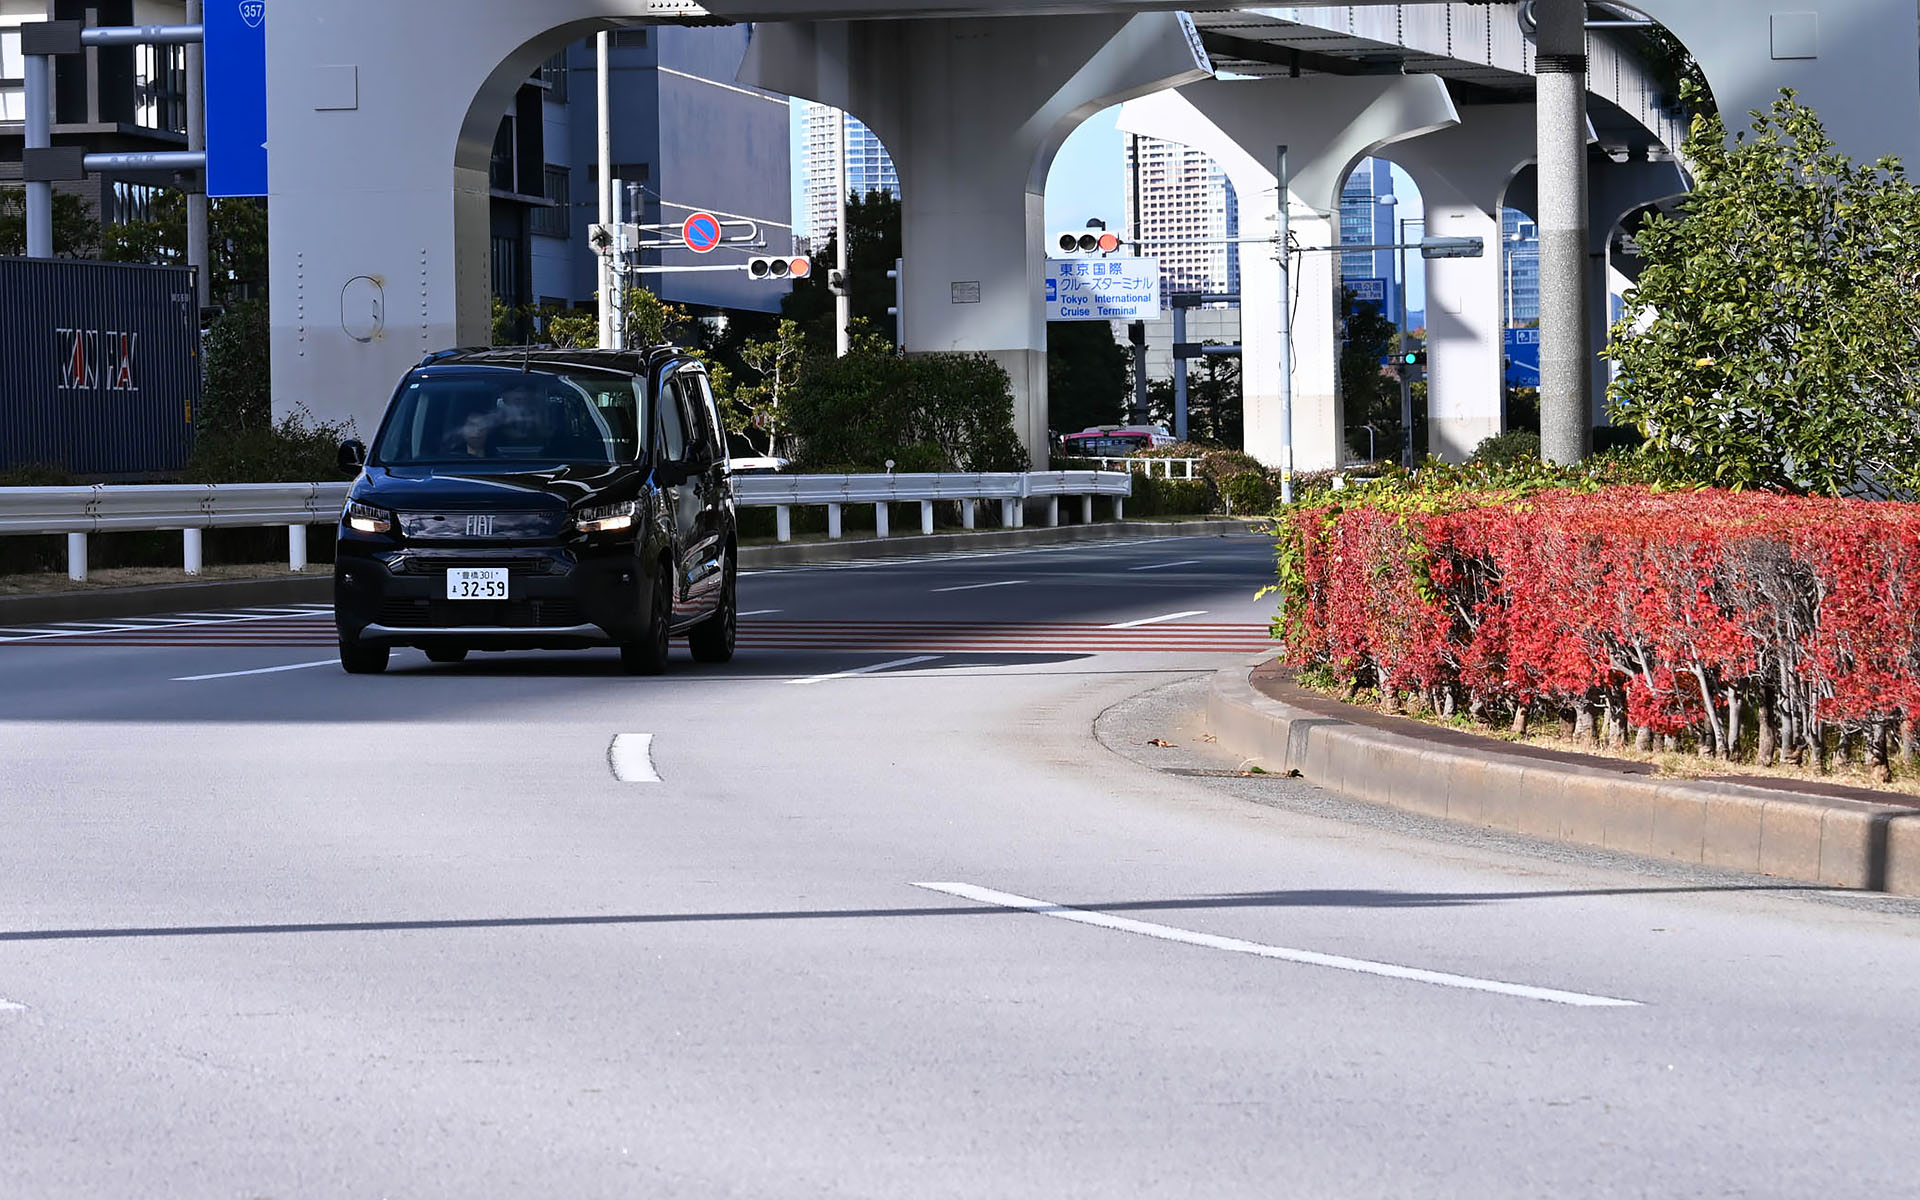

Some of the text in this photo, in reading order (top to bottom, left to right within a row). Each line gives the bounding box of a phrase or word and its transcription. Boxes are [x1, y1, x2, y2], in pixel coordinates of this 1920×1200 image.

[244, 5, 262, 17] 357
[1060, 263, 1122, 276] 東京国際
[1060, 277, 1153, 291] クルーズターミナル
[1060, 293, 1151, 305] Tokyo International
[1060, 306, 1136, 316] Cruise Terminal
[466, 514, 496, 536] FIAT
[461, 581, 505, 597] 32-59
